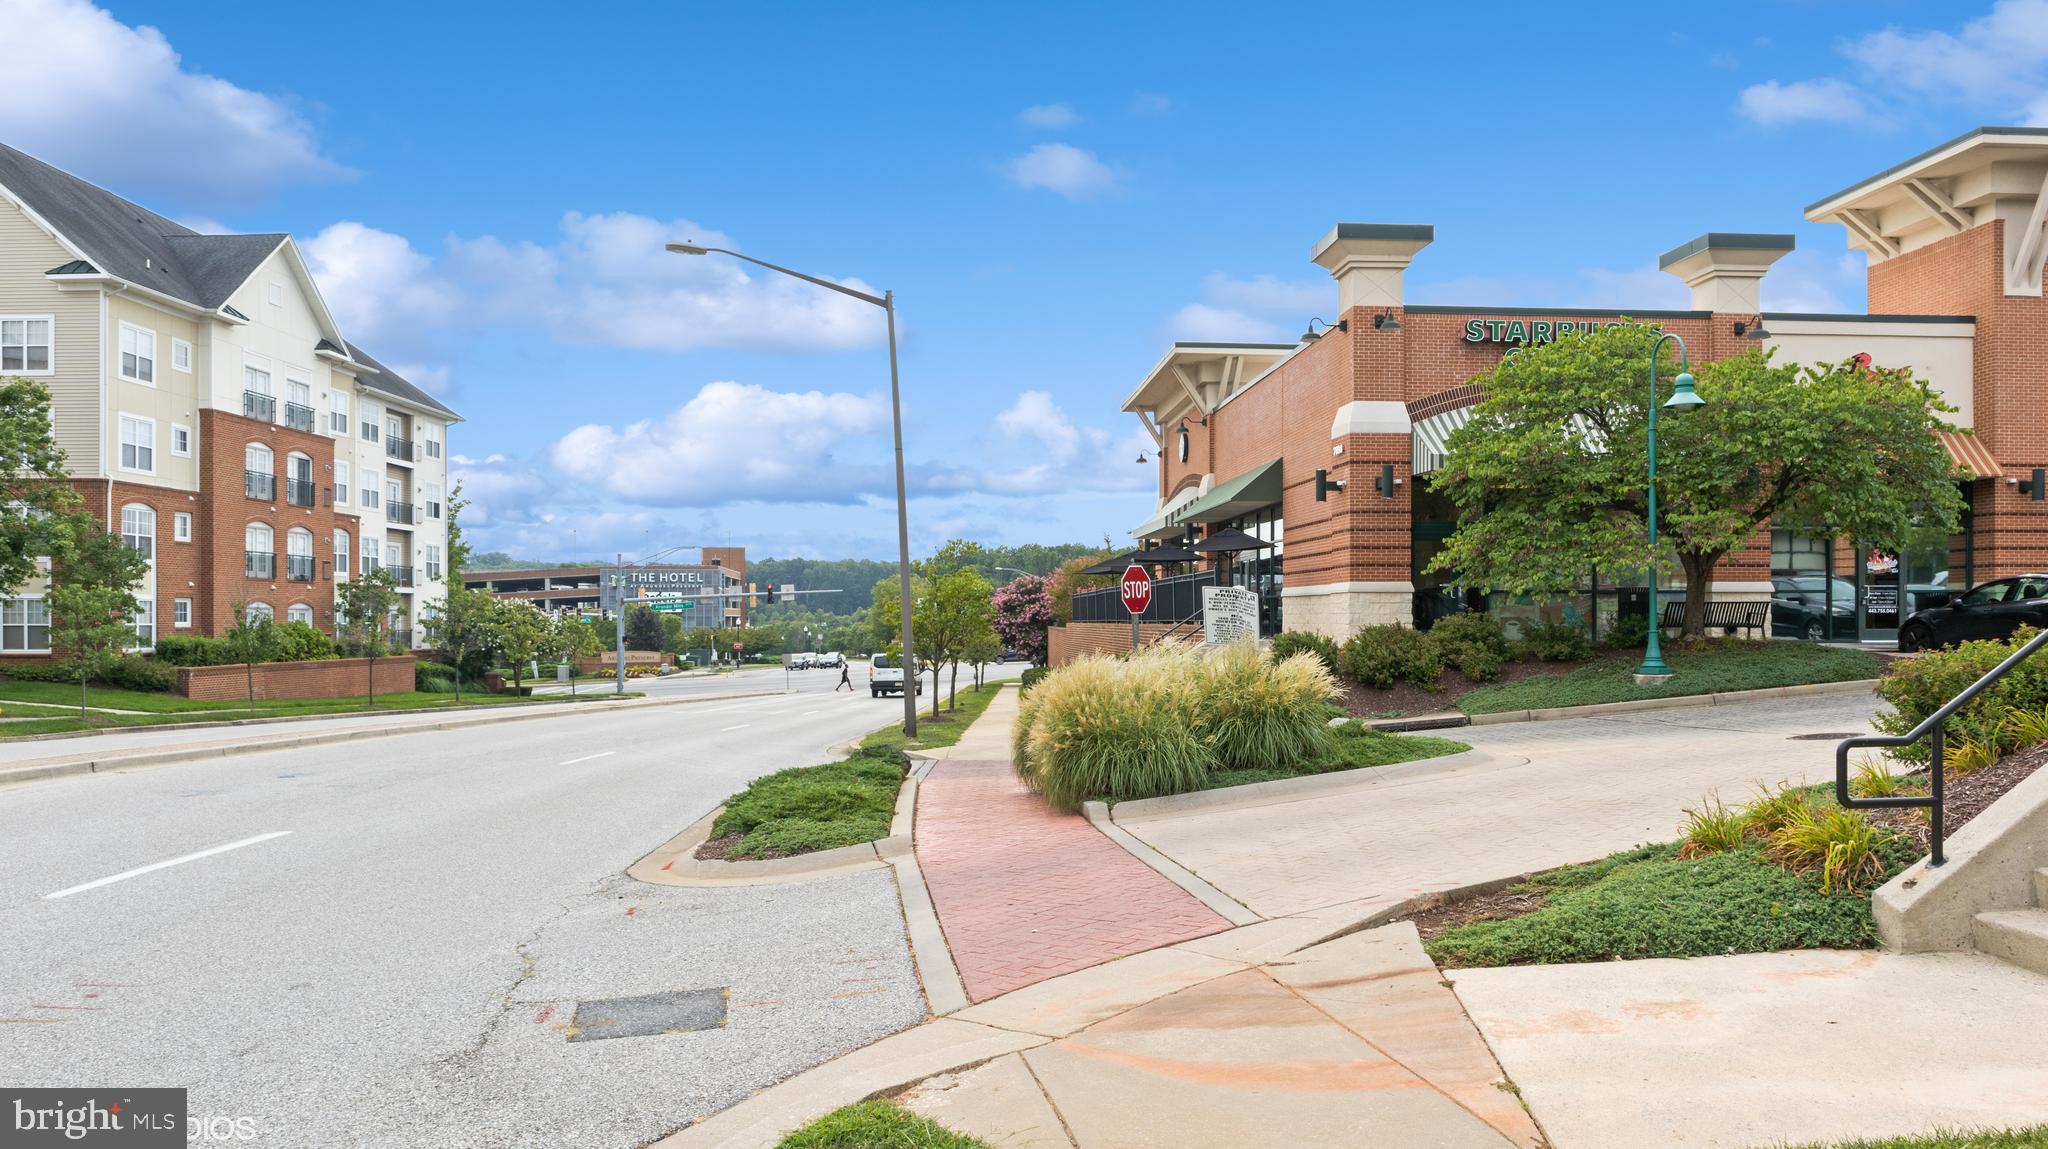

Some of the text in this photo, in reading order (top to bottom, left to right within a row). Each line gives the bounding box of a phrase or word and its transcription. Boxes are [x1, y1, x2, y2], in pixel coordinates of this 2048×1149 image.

[1466, 319, 1664, 343] STARBUS
[631, 572, 704, 582] THE HOTEL
[1123, 580, 1149, 600] STOP
[1219, 589, 1247, 597] PRIVATE
